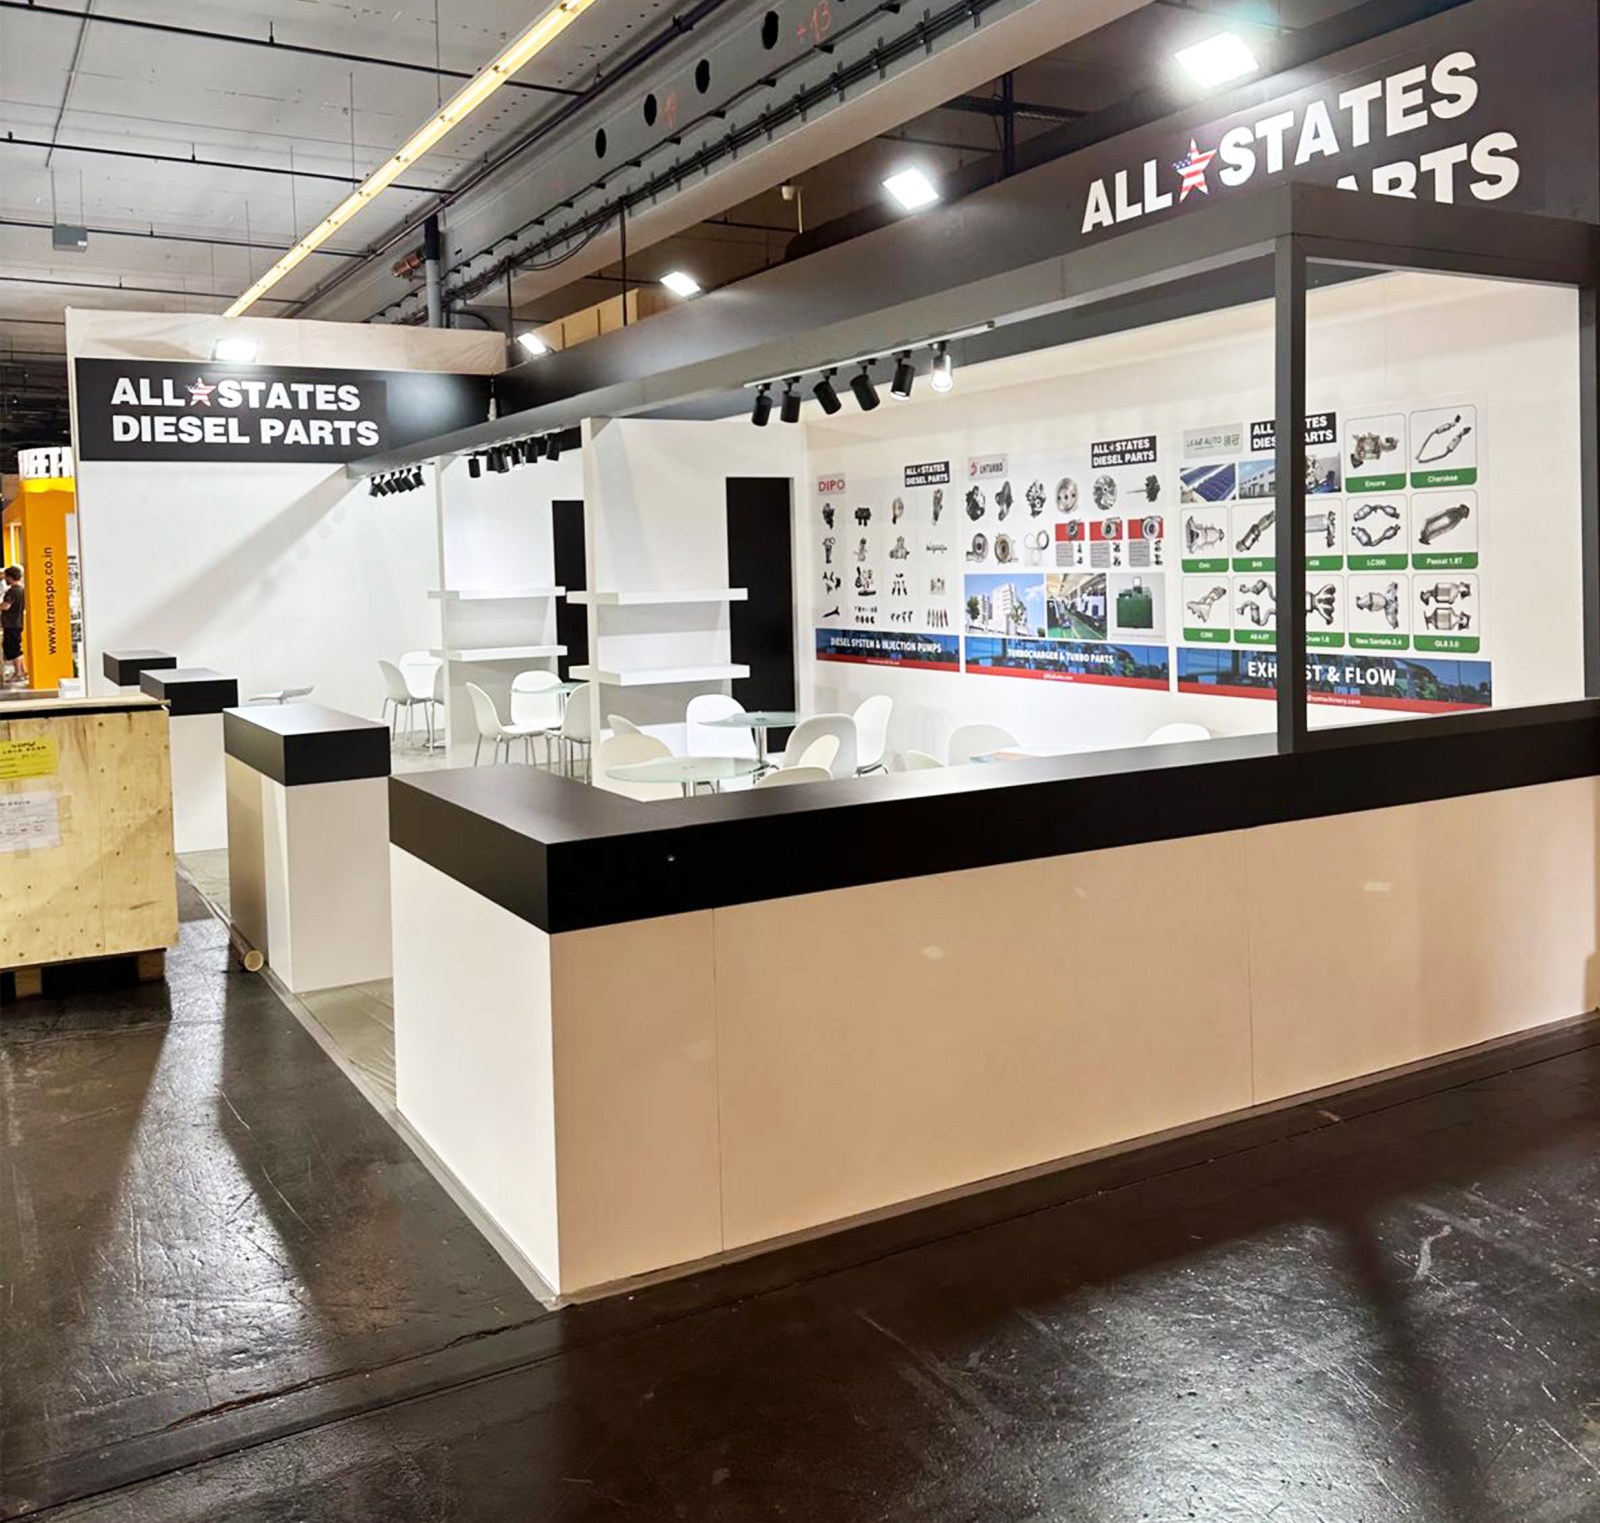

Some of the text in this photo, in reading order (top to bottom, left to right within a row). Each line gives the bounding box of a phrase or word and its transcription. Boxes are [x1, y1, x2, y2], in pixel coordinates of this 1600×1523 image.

[1081, 50, 1479, 234] ALL STATES
[111, 377, 361, 412] ALL STATES
[112, 415, 380, 447] DIESEL PARTS
[1252, 422, 1275, 436] ALL
[1092, 438, 1150, 454] ALL STATES
[1093, 450, 1155, 467] DIESEL PARTS
[920, 463, 946, 474] STATES
[818, 479, 846, 492] DIPO
[906, 472, 949, 486] DIESEL PARTS
[44, 547, 57, 655] www.transpo.co.in
[830, 637, 850, 647] DIESEL
[851, 638, 875, 648] SYSTEM
[882, 640, 916, 652] INJECTION
[917, 642, 942, 653] PUMPS
[1007, 648, 1058, 660] TURBOCHARGER
[1066, 651, 1089, 662] TURBO
[1090, 653, 1114, 664] PARTS
[1327, 665, 1340, 682] &
[1345, 667, 1397, 686] FLOW
